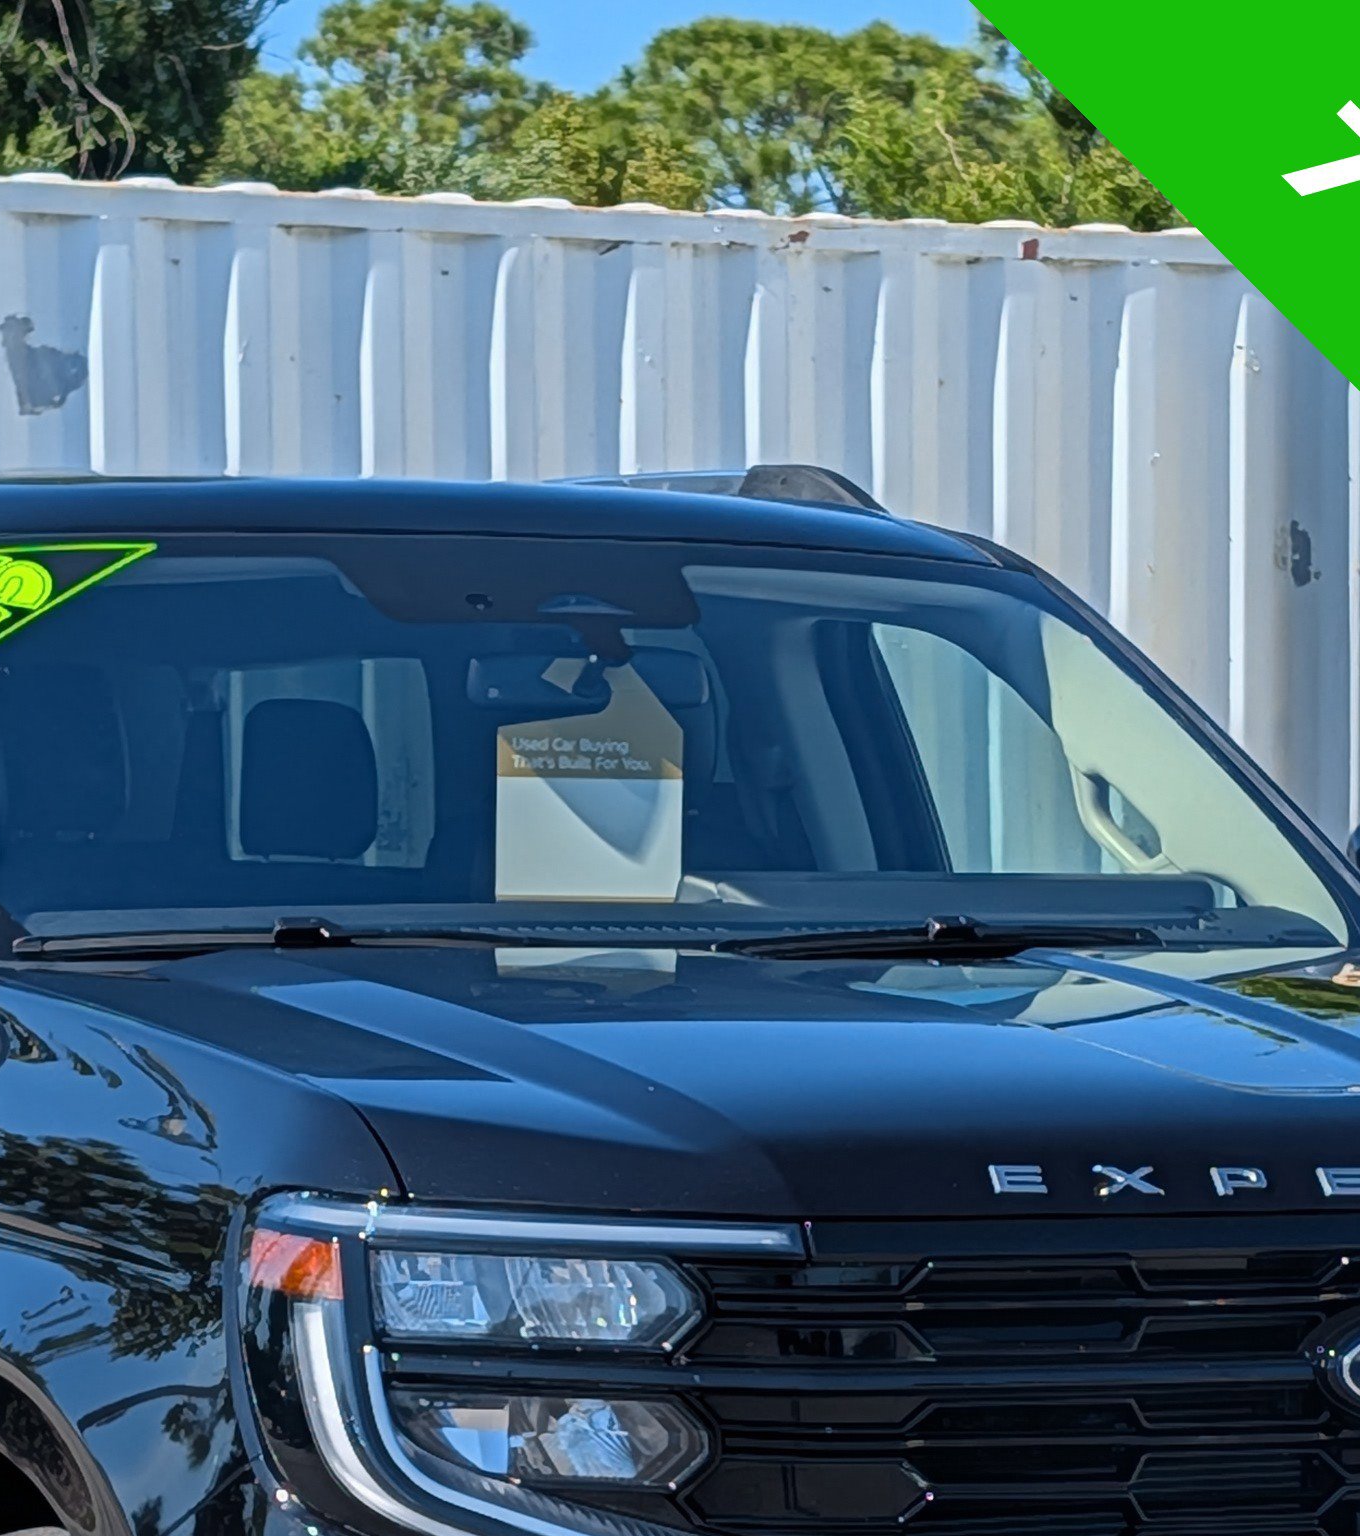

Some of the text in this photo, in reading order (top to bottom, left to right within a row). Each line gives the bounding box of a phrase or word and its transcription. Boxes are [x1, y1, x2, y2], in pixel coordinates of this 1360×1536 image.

[511, 737, 629, 755] Used Car Buying
[512, 754, 652, 771] That's Built For You.
